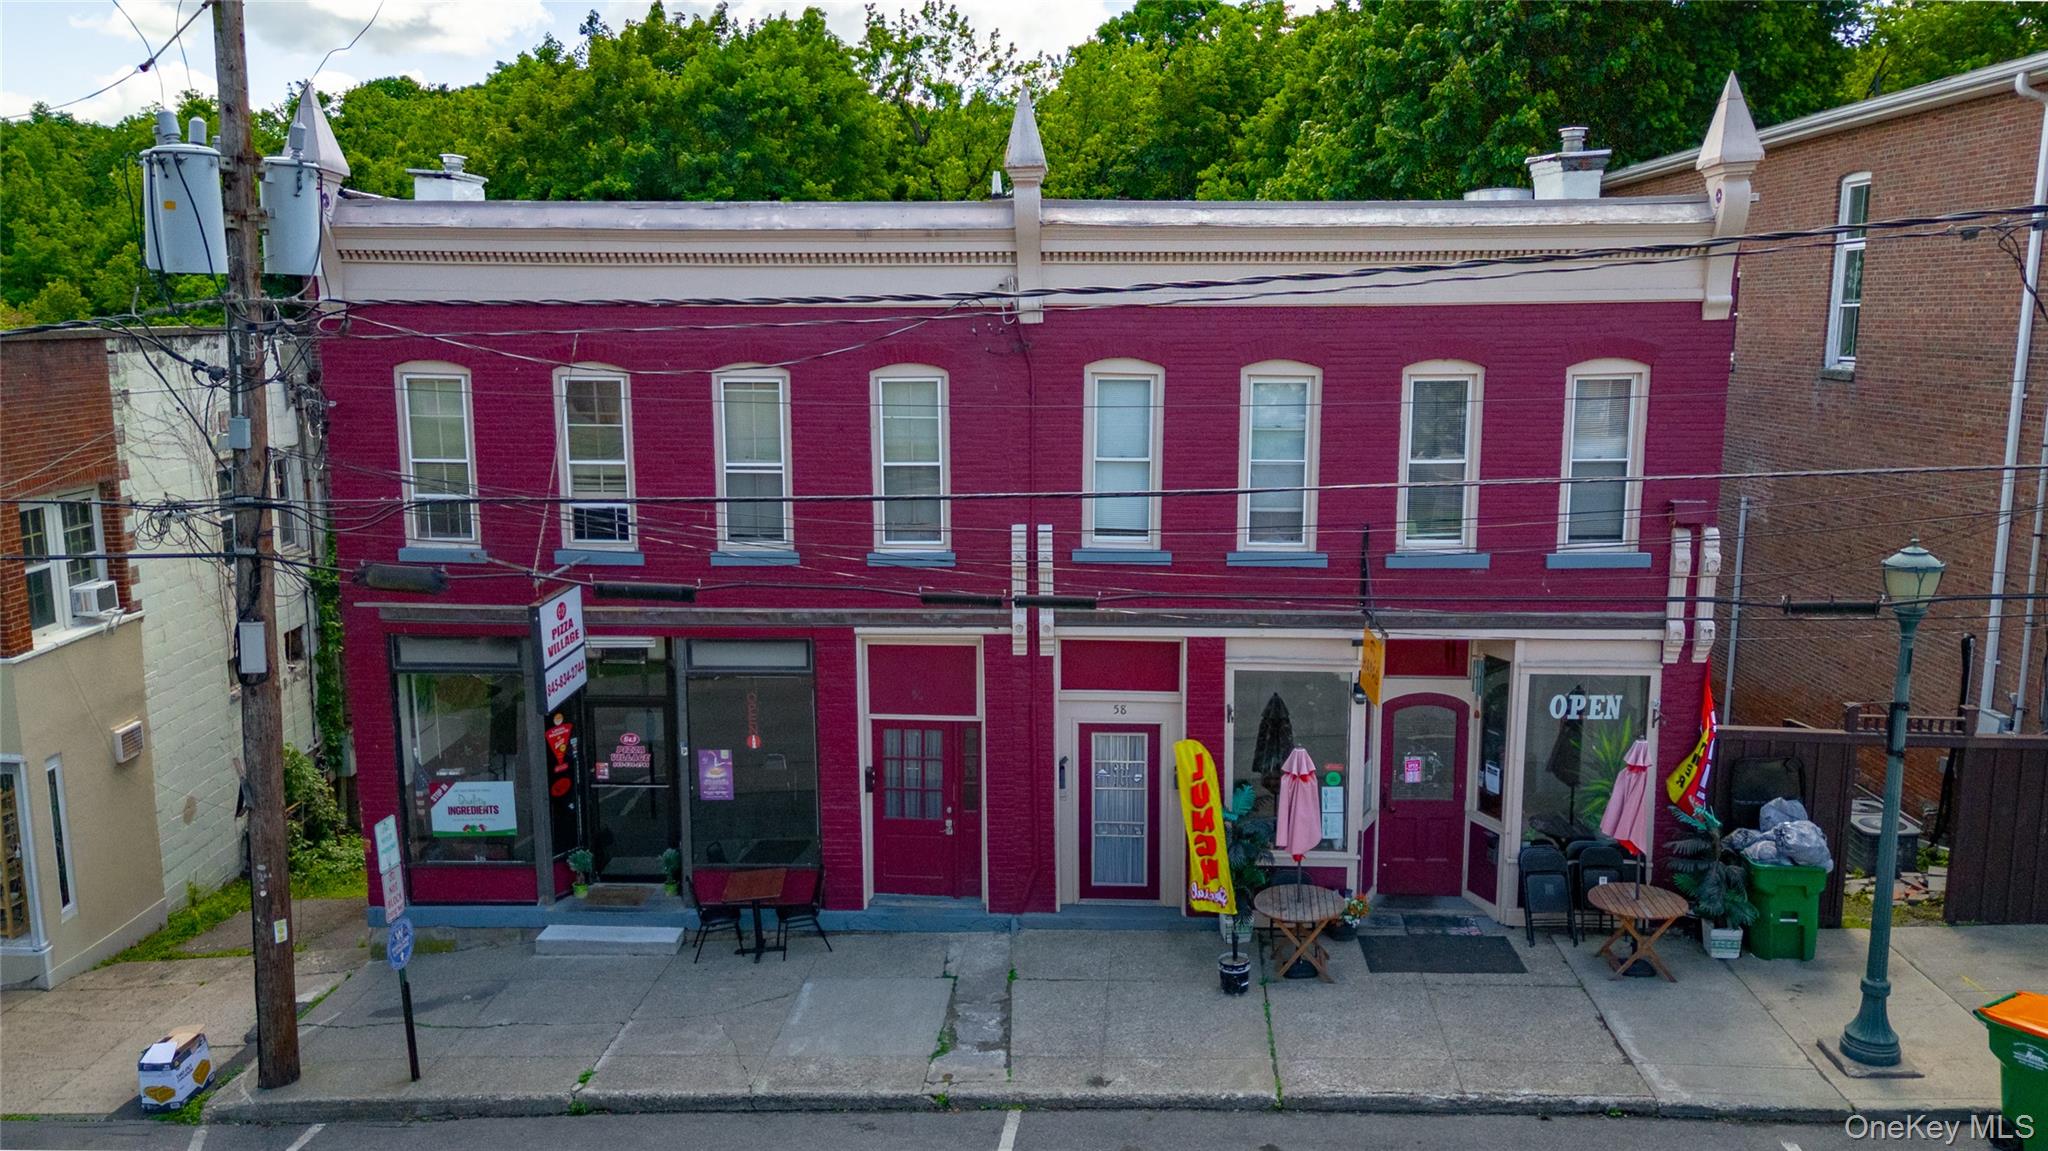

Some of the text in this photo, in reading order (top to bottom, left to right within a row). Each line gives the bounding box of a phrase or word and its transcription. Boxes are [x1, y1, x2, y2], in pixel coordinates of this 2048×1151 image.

[551, 618, 574, 640] PIZZA
[547, 629, 580, 657] VILLAGE
[546, 659, 585, 697] 845-834-2744
[1113, 704, 1127, 715] 58
[1549, 694, 1623, 720] OPEN
[610, 753, 651, 762] VILLAGE
[616, 745, 646, 754] PIZZA
[430, 783, 449, 802] STOP IN
[447, 805, 500, 816] INGREDIENTS
